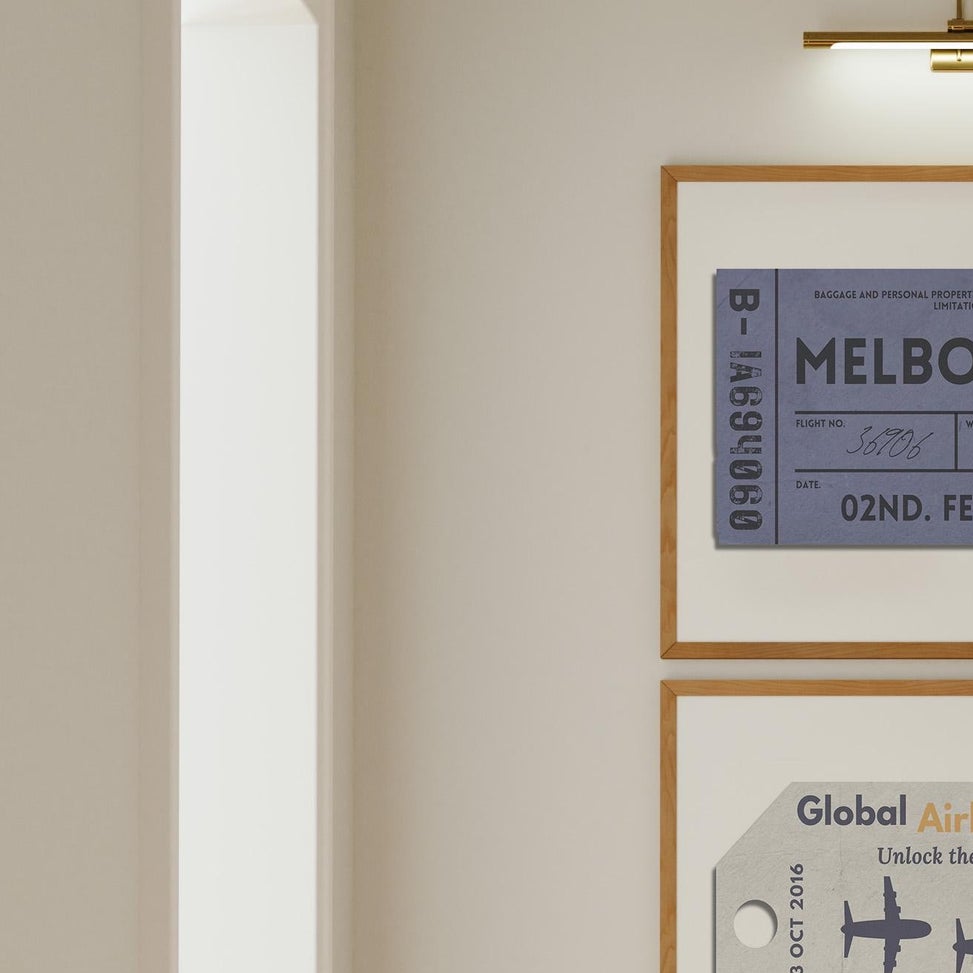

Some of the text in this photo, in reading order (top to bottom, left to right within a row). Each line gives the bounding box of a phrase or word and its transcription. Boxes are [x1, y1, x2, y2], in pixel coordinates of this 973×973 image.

[814, 290, 857, 300] BAGGAGE
[859, 290, 879, 300] AND
[882, 290, 929, 300] PERSONAL
[795, 419, 846, 429] FLIGHT NO.
[795, 480, 822, 490] DATE.
[841, 494, 931, 522] 02ND.
[797, 794, 907, 826] Global
[877, 846, 944, 865] Unlock
[789, 863, 804, 911] 2016
[789, 918, 804, 959] OCT
